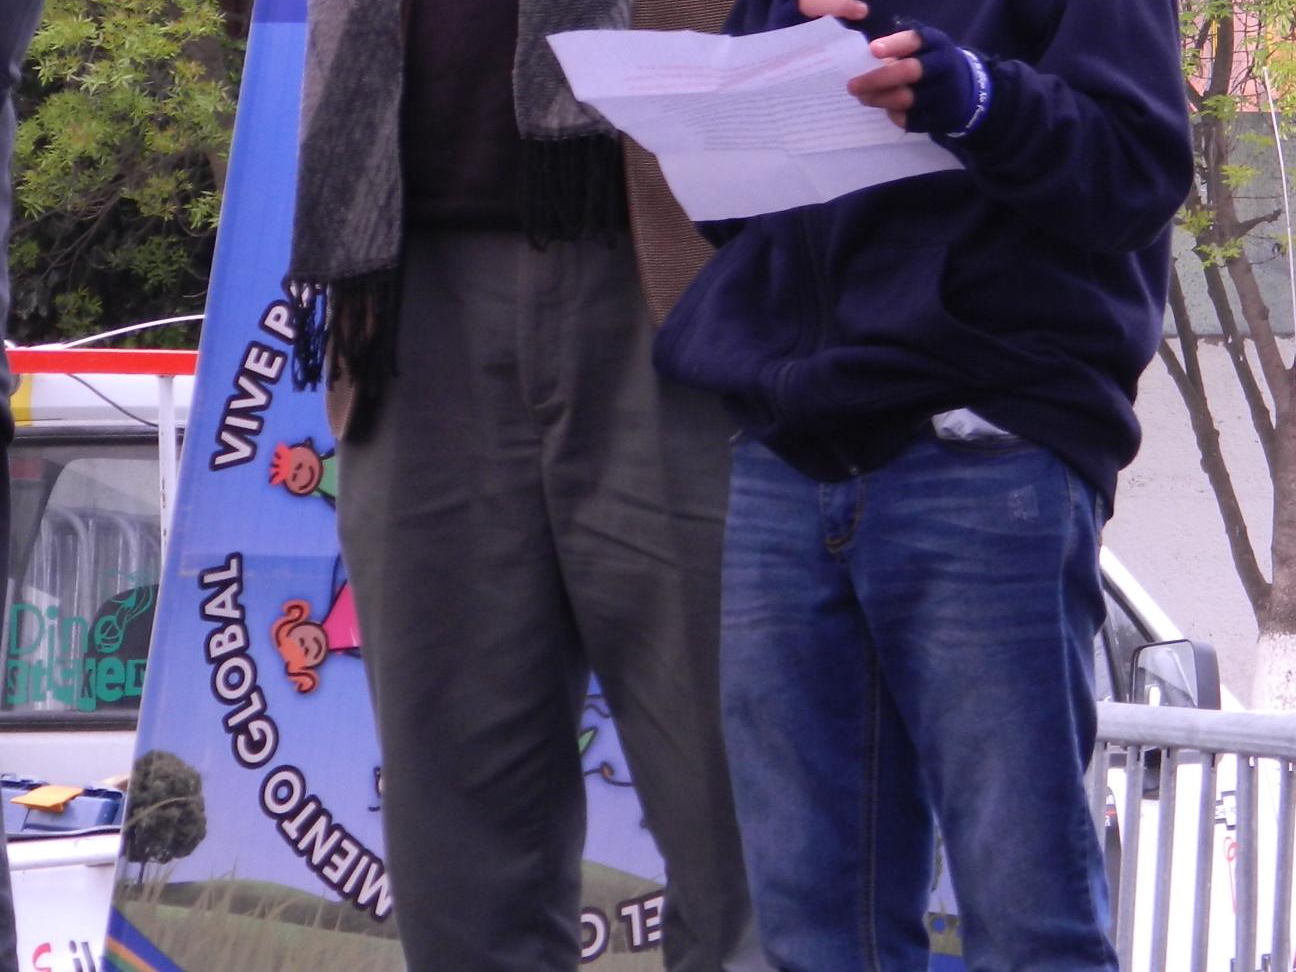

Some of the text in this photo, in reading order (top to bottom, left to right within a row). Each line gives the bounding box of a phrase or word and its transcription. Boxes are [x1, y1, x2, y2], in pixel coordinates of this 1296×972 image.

[212, 344, 286, 468] VIVE
[202, 556, 275, 766] GLOBAL
[262, 768, 394, 918] MIENTO
